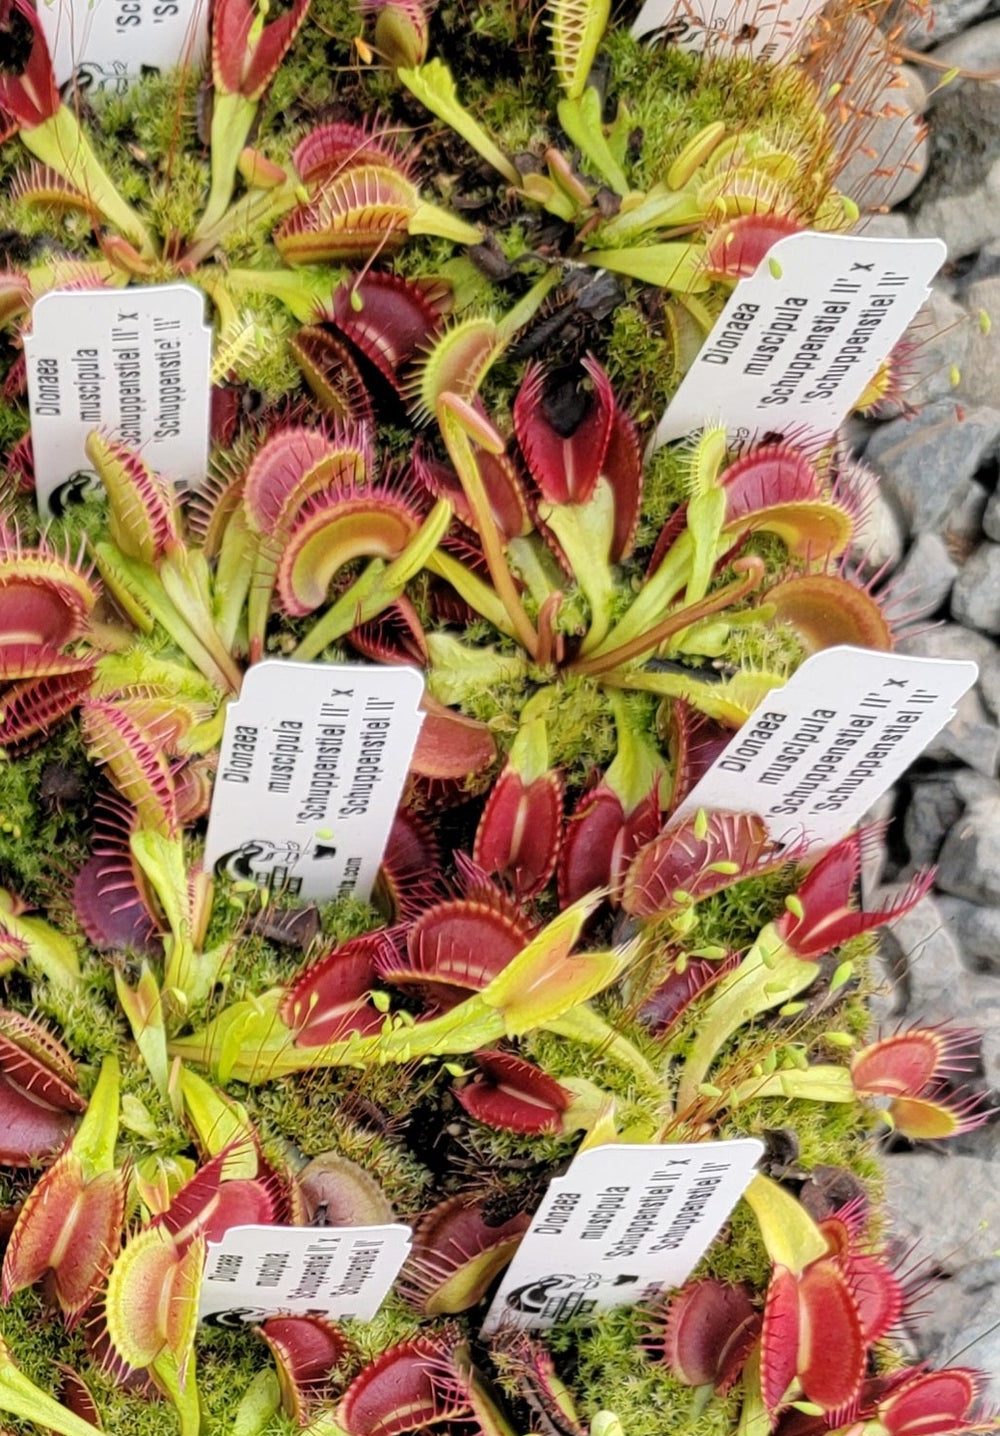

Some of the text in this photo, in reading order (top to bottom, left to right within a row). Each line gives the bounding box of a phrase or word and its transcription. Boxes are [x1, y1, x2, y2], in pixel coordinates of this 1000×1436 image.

[117, 312, 138, 321] x
[701, 302, 760, 365] Dionaea
[743, 296, 808, 376] muscipula
[757, 300, 850, 408] 'Schuppenstiel
[850, 262, 876, 272] x
[800, 294, 896, 404] 'Schuppenstiel
[35, 358, 61, 416] Dionaea
[72, 349, 106, 422] muscipula
[112, 348, 146, 446] Schuppenstiel
[222, 725, 258, 784] Dionaea
[268, 720, 304, 793] muscipula
[296, 724, 346, 824] 'Schuppenstiel
[331, 689, 354, 697] x
[337, 717, 390, 820] 'Schuppenstiel
[717, 711, 788, 773] Dionaea
[758, 708, 837, 786] muscipula
[765, 713, 877, 818] 'Schuppenstiel
[883, 678, 910, 688] x
[808, 710, 923, 815] 'Schuppenstiel
[533, 1192, 581, 1235] Dionaea
[579, 1186, 631, 1240] muscipula
[602, 1186, 675, 1261] 'Schuppenstiel
[647, 1176, 722, 1255] 'Schuppenstiel
